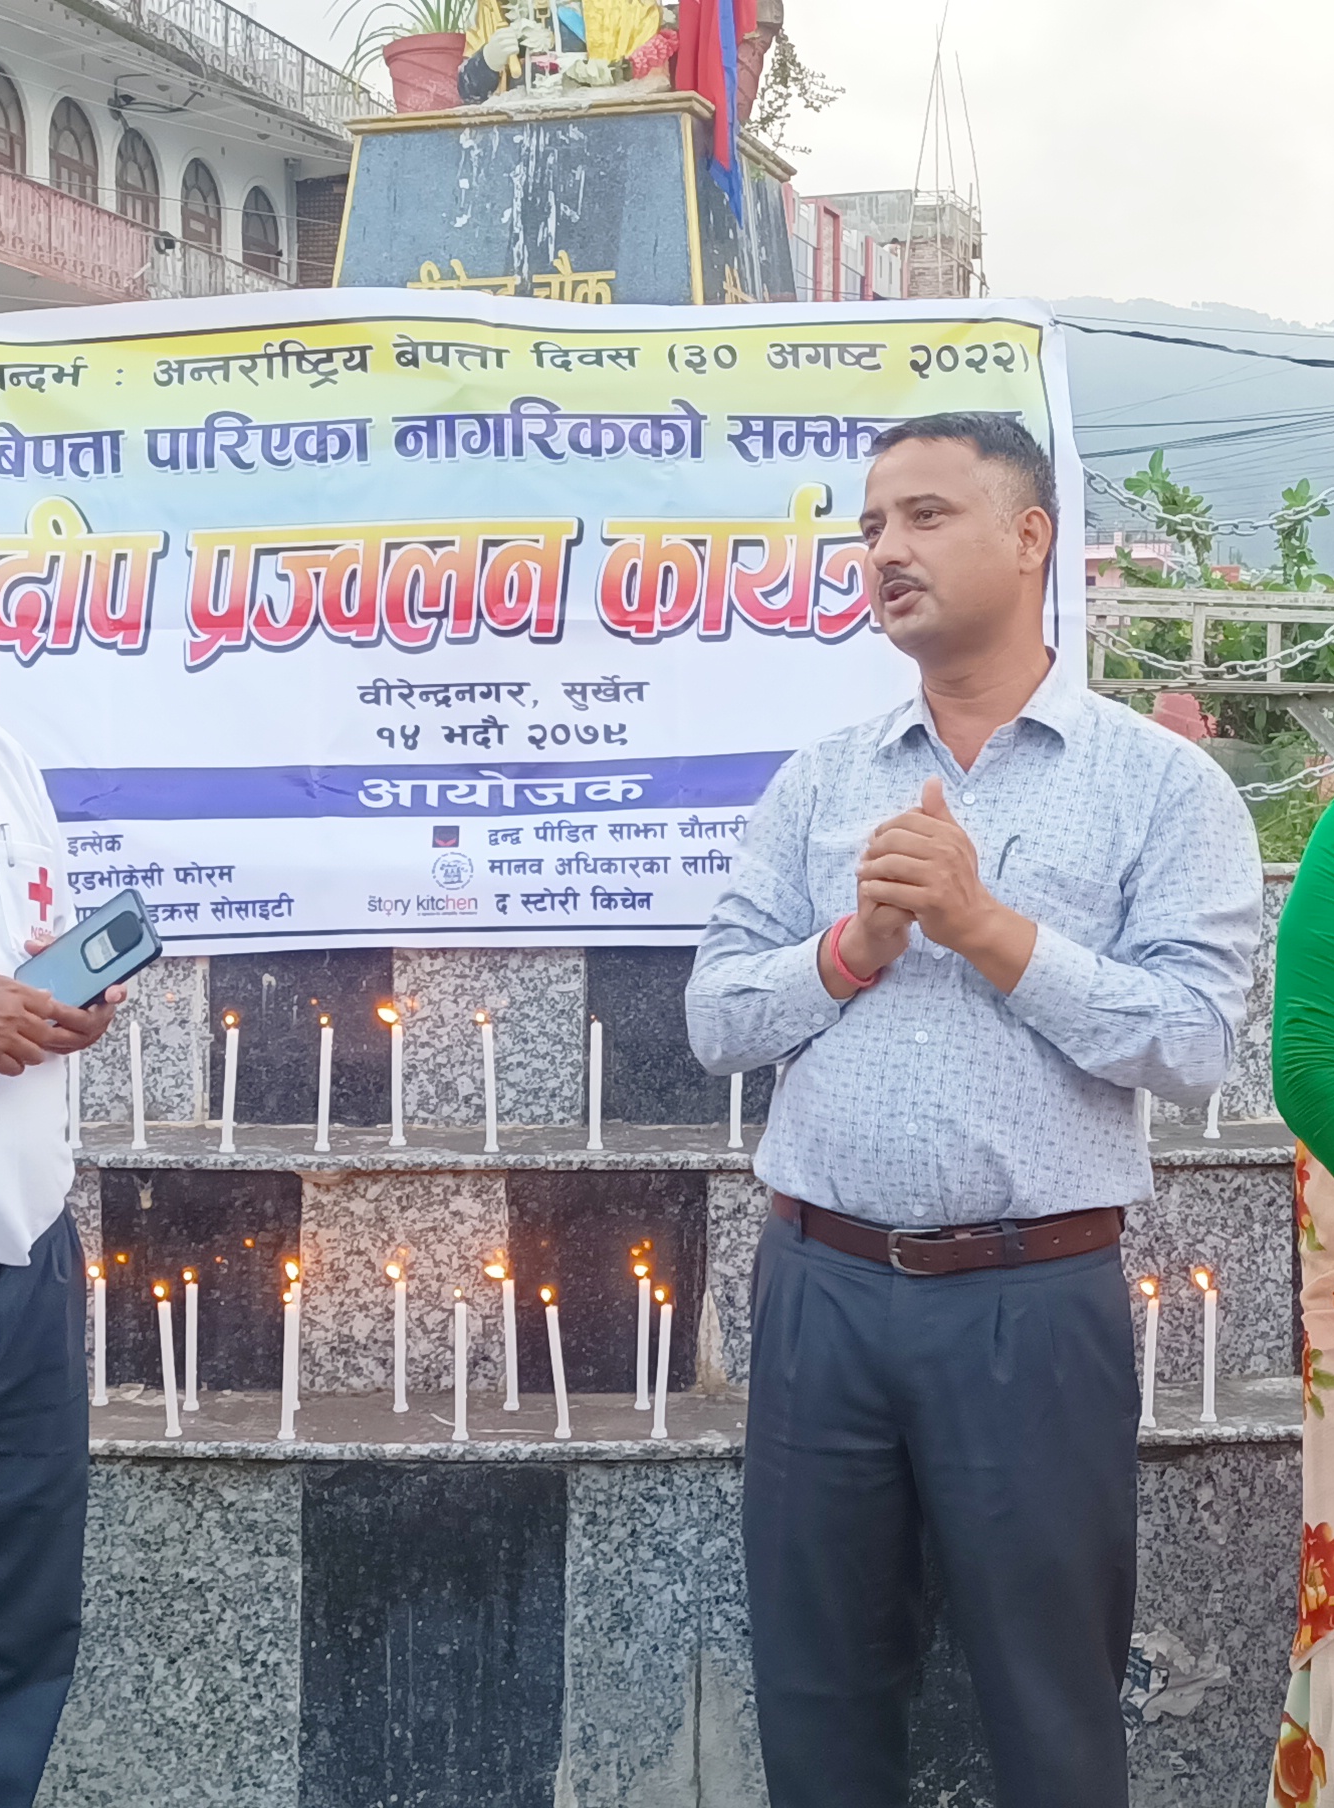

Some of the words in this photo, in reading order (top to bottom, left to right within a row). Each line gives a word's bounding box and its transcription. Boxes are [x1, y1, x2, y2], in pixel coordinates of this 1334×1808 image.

[393, 334, 510, 371] बेपत्ता
[531, 342, 640, 371] दिवस
[667, 343, 737, 374] (३०
[766, 342, 886, 372] अगष्ट
[910, 340, 1030, 379] २०२२)
[144, 411, 373, 472] पारिएका
[392, 396, 707, 463] नागरिकको
[184, 516, 582, 671] प्रज्वलन
[598, 481, 883, 645] कार्यक्र
[357, 678, 539, 710] वीरेन्द्रनगर,
[561, 675, 650, 711] सुर्खेत
[376, 724, 421, 751] १४
[441, 714, 509, 749] भदौ
[527, 723, 628, 750] २०७९
[358, 770, 653, 809] आयोजक
[67, 831, 124, 856] इन्सेक
[488, 827, 523, 846] द्वन्द्व
[534, 820, 598, 843] पीडित
[608, 822, 668, 842] साझा
[677, 814, 751, 842] चौतारी
[67, 861, 165, 894] एडभोकेसी
[173, 861, 236, 888] फोरम
[488, 858, 544, 876] मानव
[555, 852, 671, 878] अधिकारका
[681, 849, 733, 876] लागि
[210, 892, 295, 922] सोसाइटी
[416, 894, 478, 911] kitchen
[494, 893, 511, 915] द
[521, 886, 581, 915] स्टोरी
[590, 885, 654, 911] किचेन
